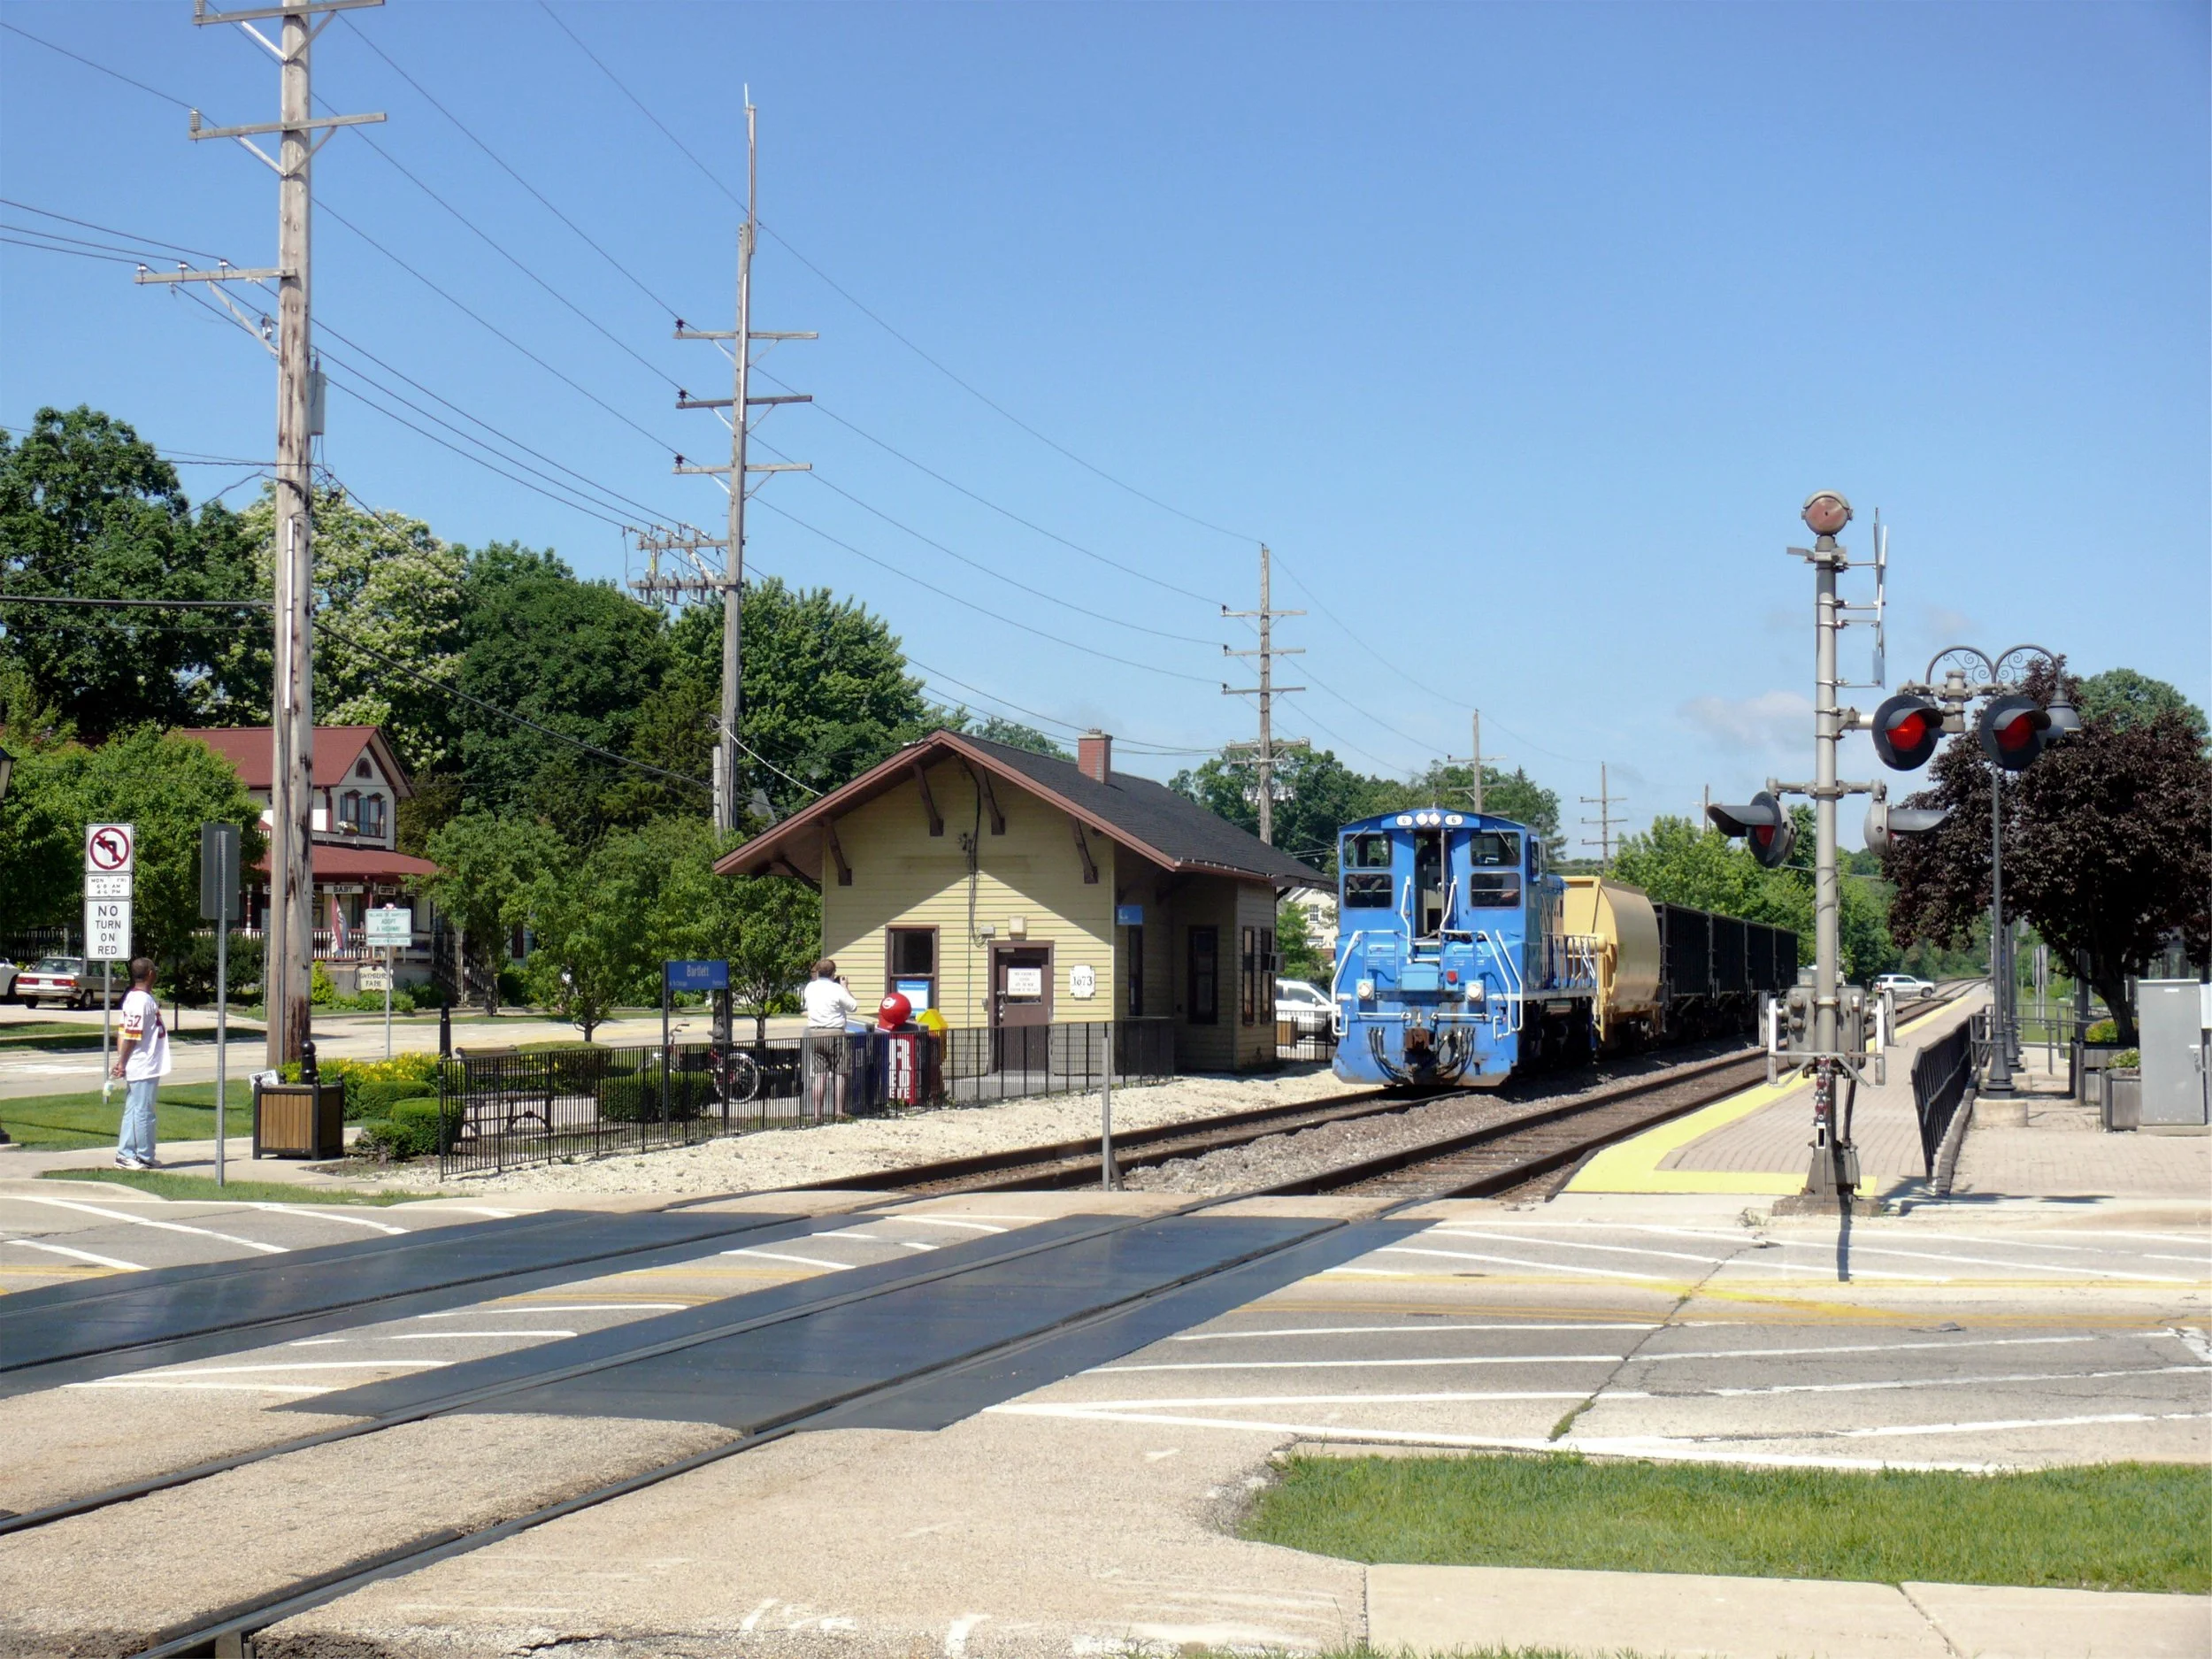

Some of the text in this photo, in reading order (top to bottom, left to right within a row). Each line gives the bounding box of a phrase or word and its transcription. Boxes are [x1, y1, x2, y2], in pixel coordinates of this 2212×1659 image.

[98, 905, 119, 917] NO
[96, 919, 121, 929] TURN
[100, 933, 115, 942] ON
[97, 945, 117, 955] RED
[687, 964, 710, 978] Bartlett
